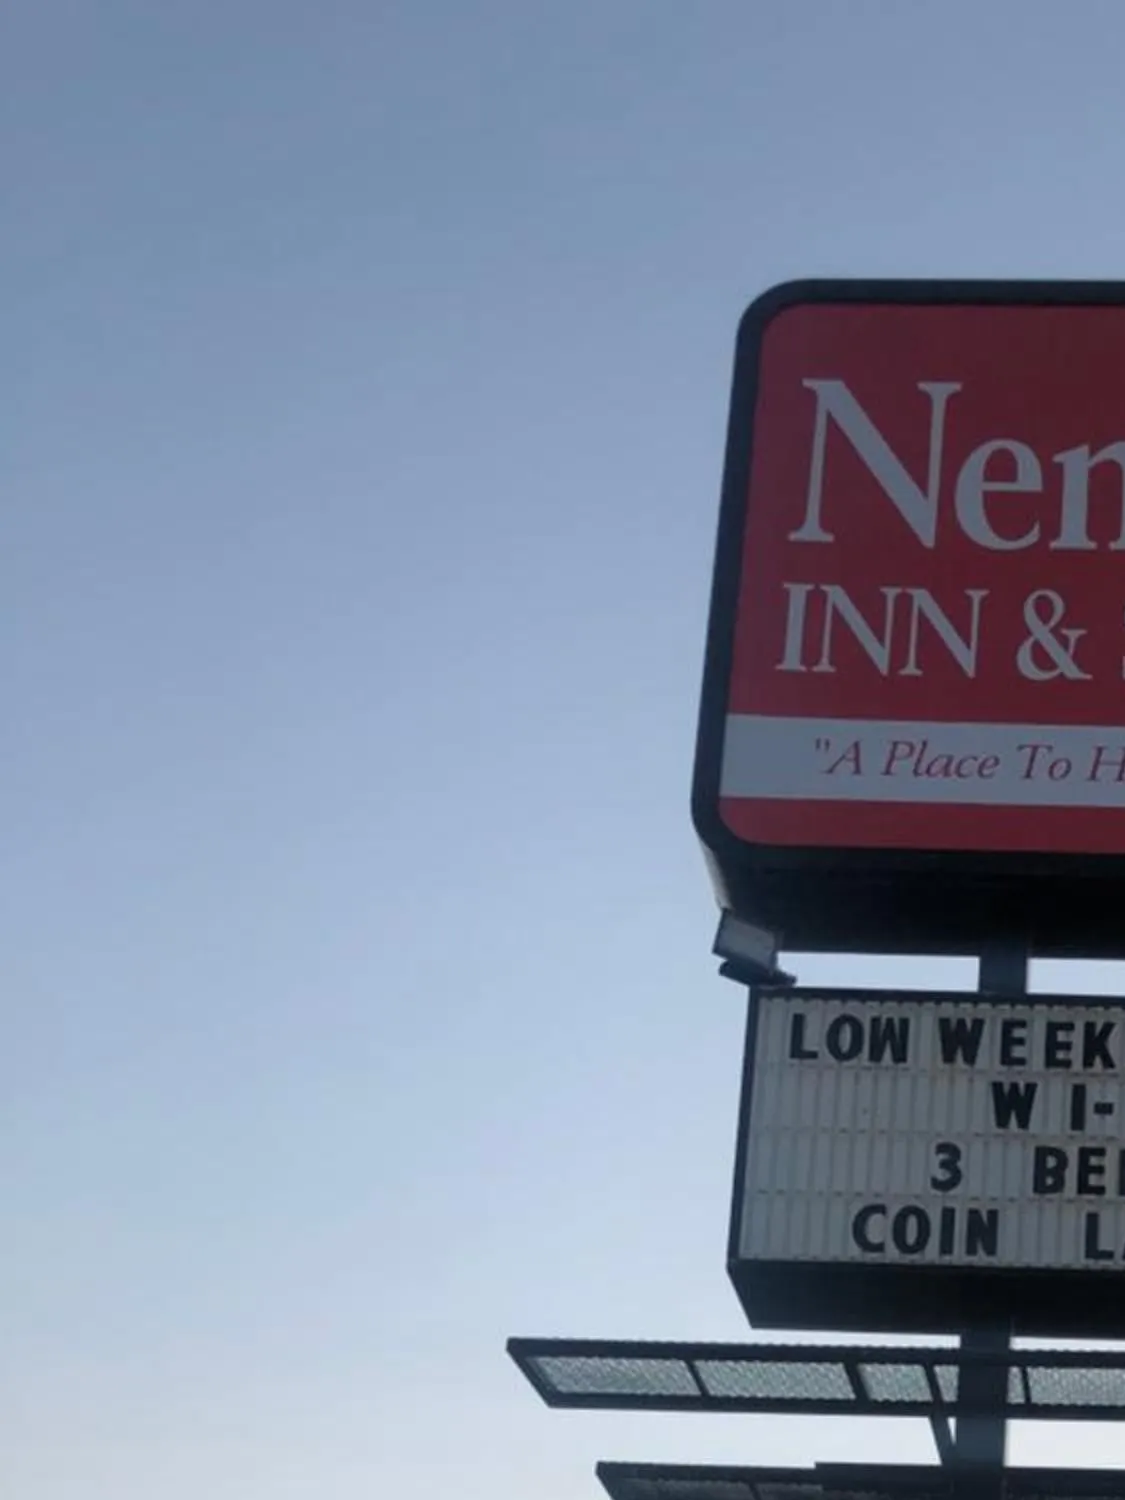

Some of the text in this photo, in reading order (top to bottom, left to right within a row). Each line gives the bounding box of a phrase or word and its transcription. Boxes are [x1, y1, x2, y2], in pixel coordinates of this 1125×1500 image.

[775, 582, 990, 680] INN
[1015, 588, 1094, 682] &
[881, 738, 1001, 780] Place
[1016, 743, 1074, 782] To
[788, 1012, 912, 1063] LOW
[930, 1142, 963, 1193] 3
[851, 1203, 1001, 1258] COIN
